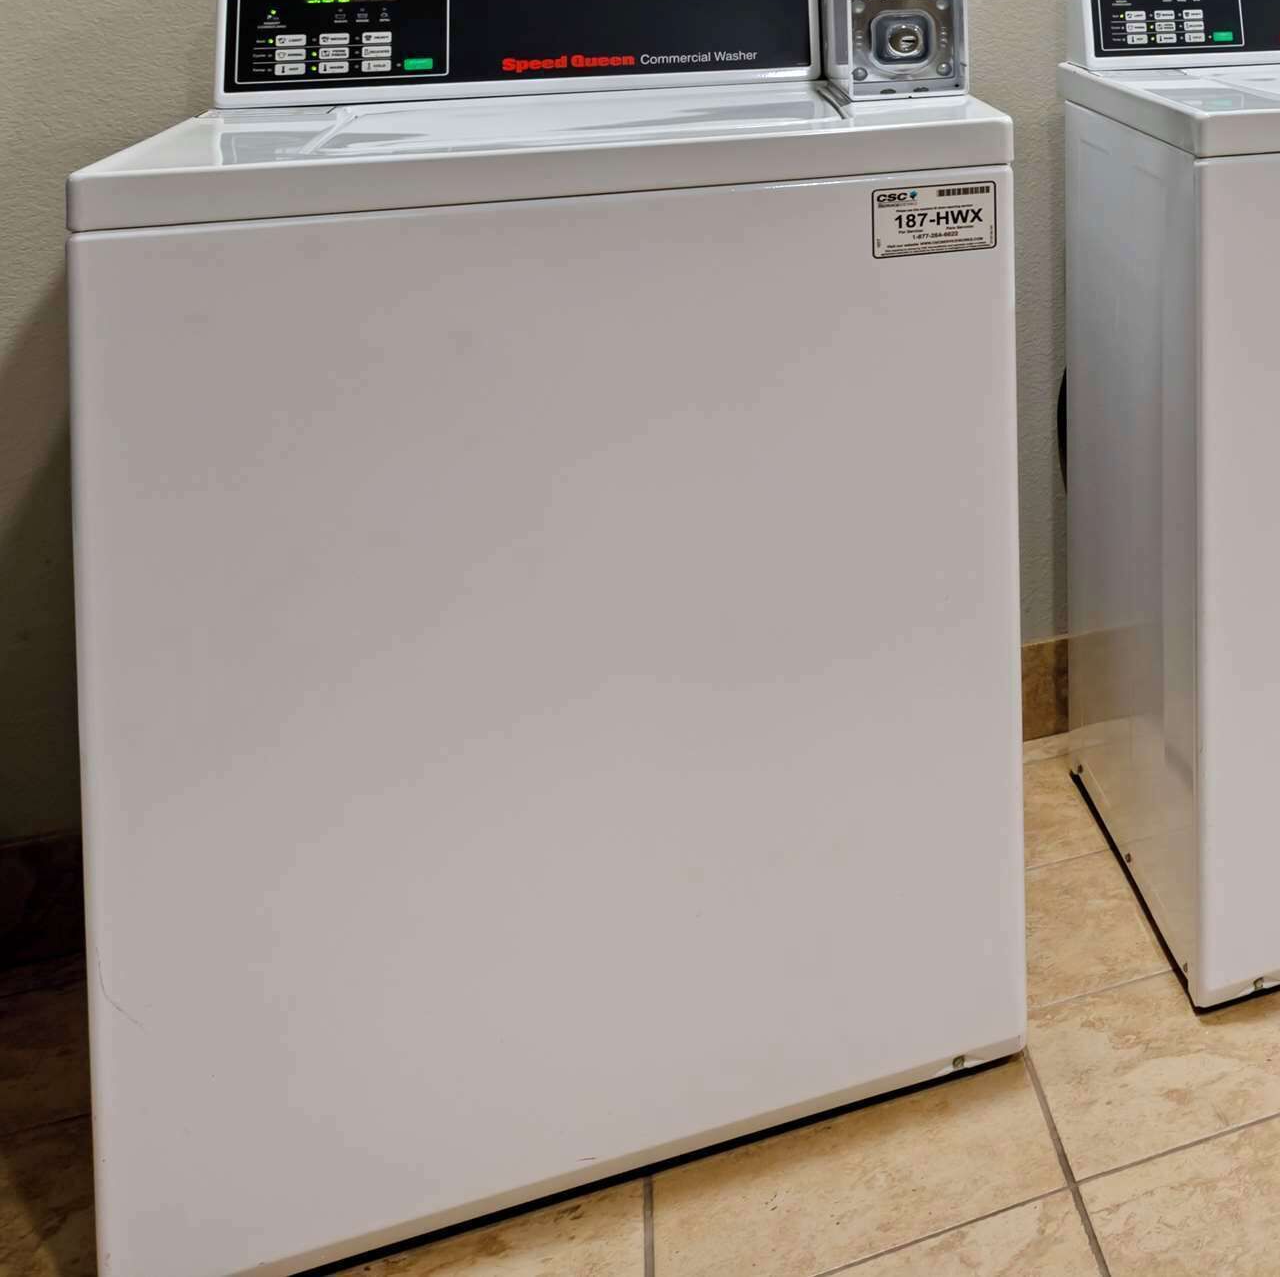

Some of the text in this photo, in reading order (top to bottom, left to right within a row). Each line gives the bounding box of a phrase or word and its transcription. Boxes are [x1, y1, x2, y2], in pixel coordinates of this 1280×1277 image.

[502, 50, 758, 73] Speed Queen Commercial Washer
[877, 192, 908, 203] CSC
[895, 208, 983, 229] 187-HWX
